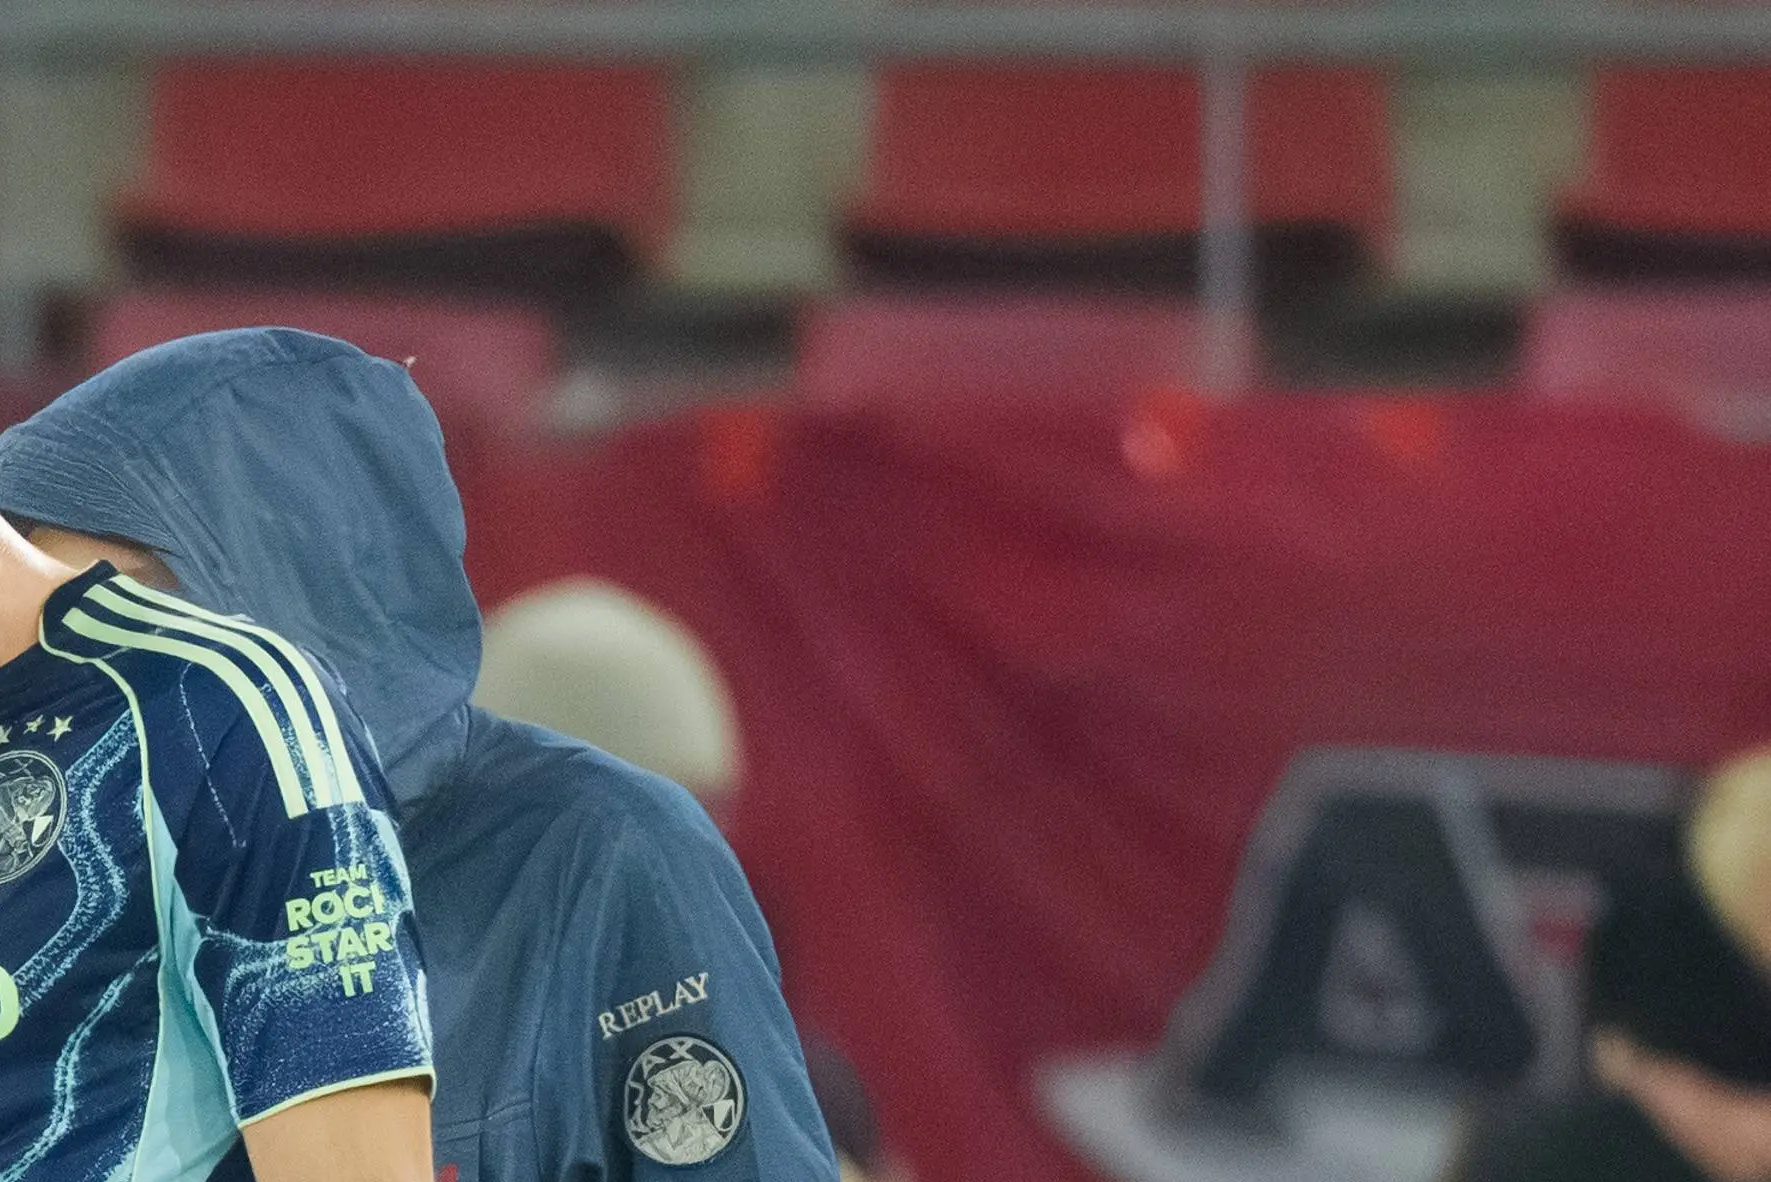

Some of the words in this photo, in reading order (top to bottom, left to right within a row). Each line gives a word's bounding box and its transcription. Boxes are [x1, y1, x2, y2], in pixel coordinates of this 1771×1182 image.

[310, 863, 368, 888] TEAM
[339, 961, 377, 997] IT
[598, 972, 709, 1040] REPLAY
